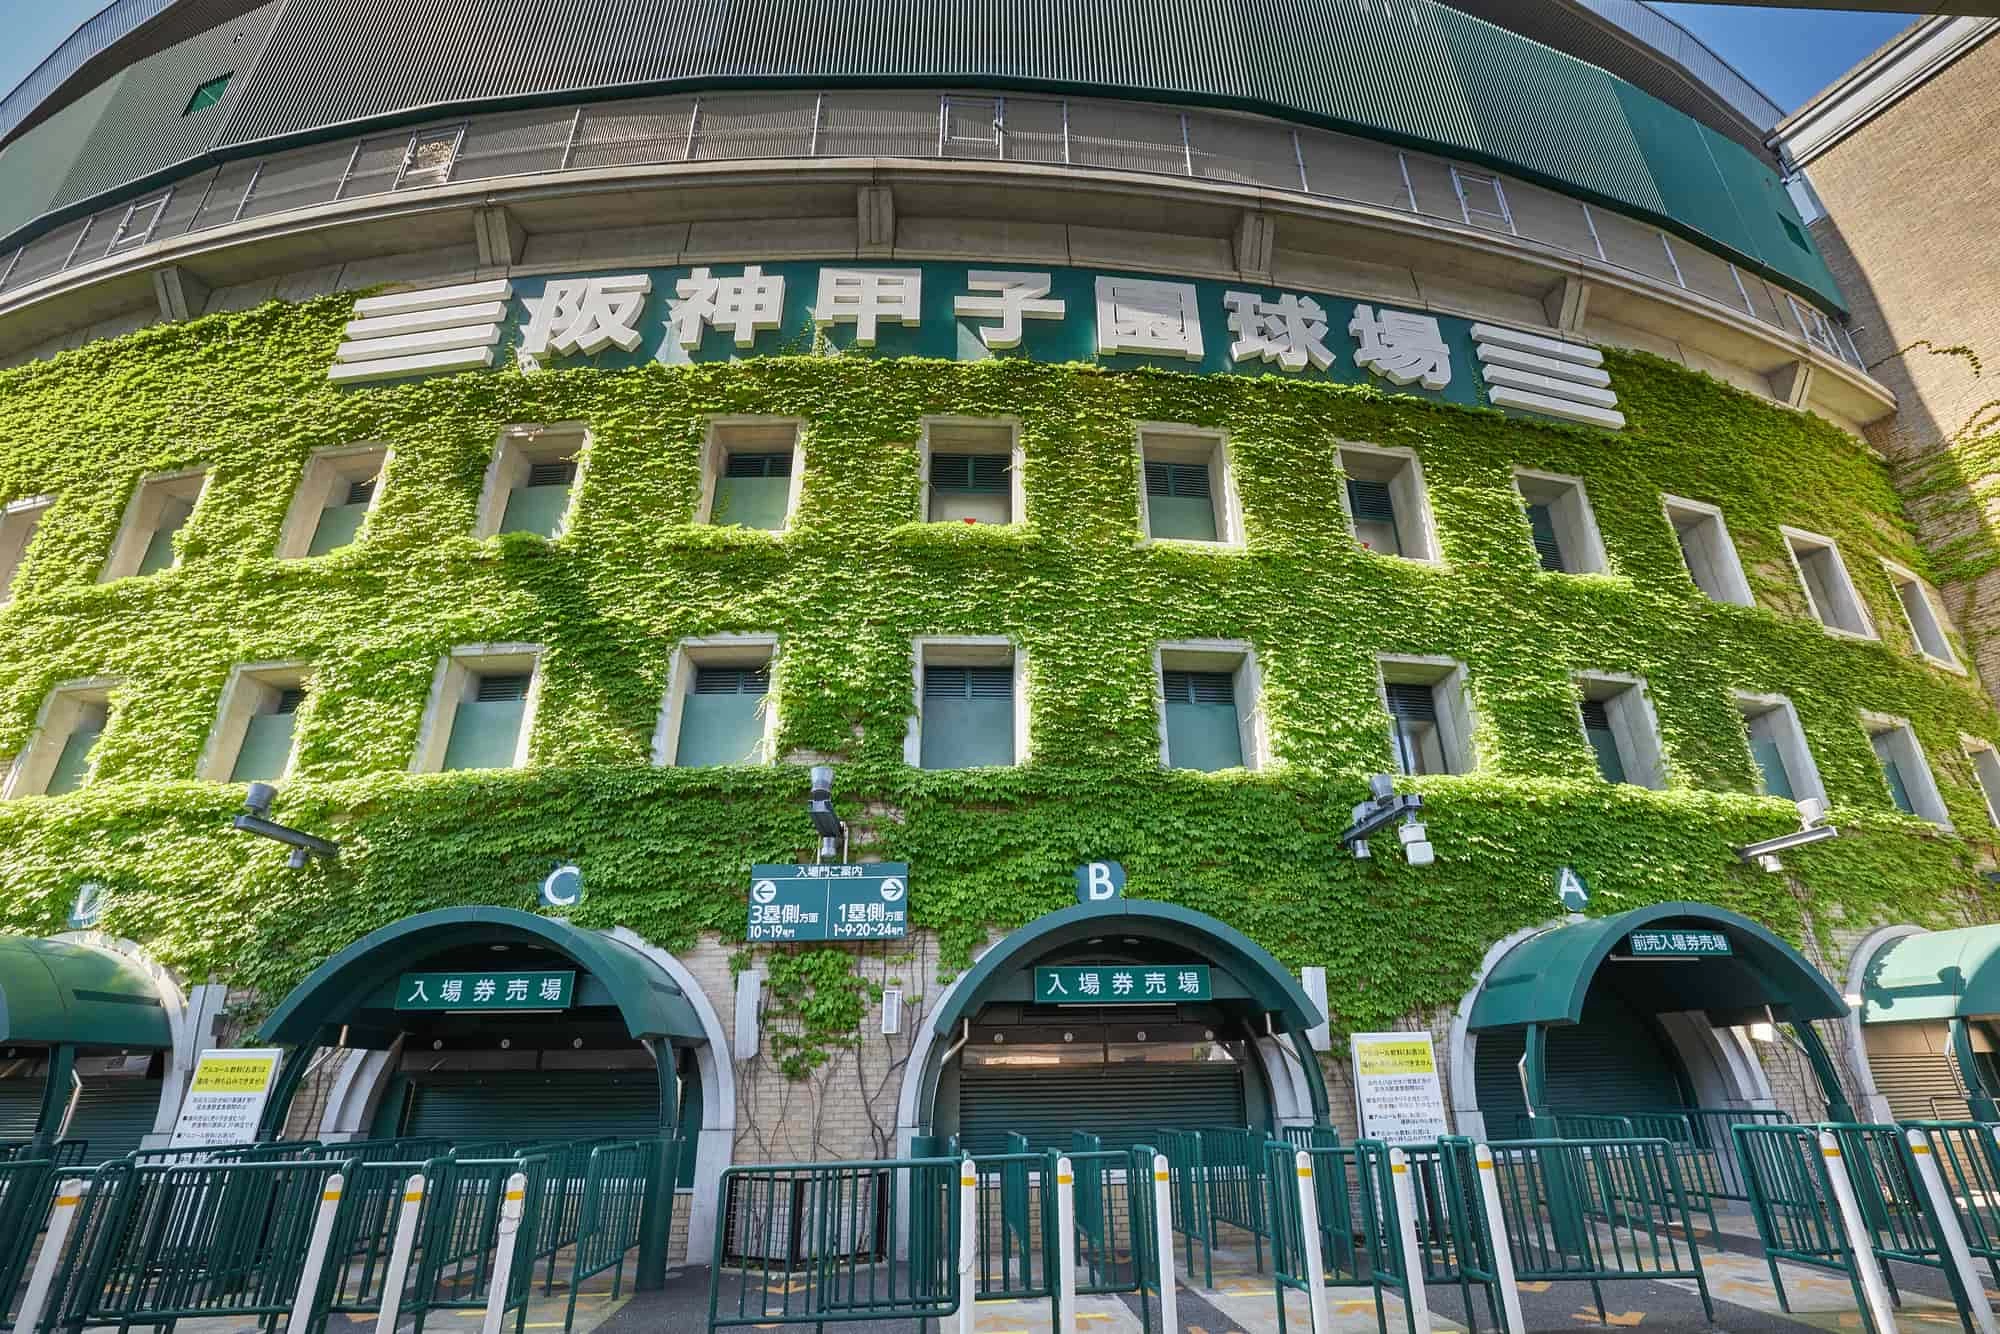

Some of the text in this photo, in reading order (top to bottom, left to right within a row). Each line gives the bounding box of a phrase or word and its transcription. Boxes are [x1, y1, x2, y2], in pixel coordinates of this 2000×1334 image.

[521, 265, 1452, 389] 阪神甲子園球場
[545, 866, 580, 906] C
[796, 866, 864, 878] 入場門ご案内
[1088, 862, 1115, 901] B
[1558, 867, 1588, 901] A
[1631, 933, 1728, 951] 前売入場券売場
[407, 978, 563, 1003] 入場券売場
[1046, 971, 1202, 995] 入場券売場
